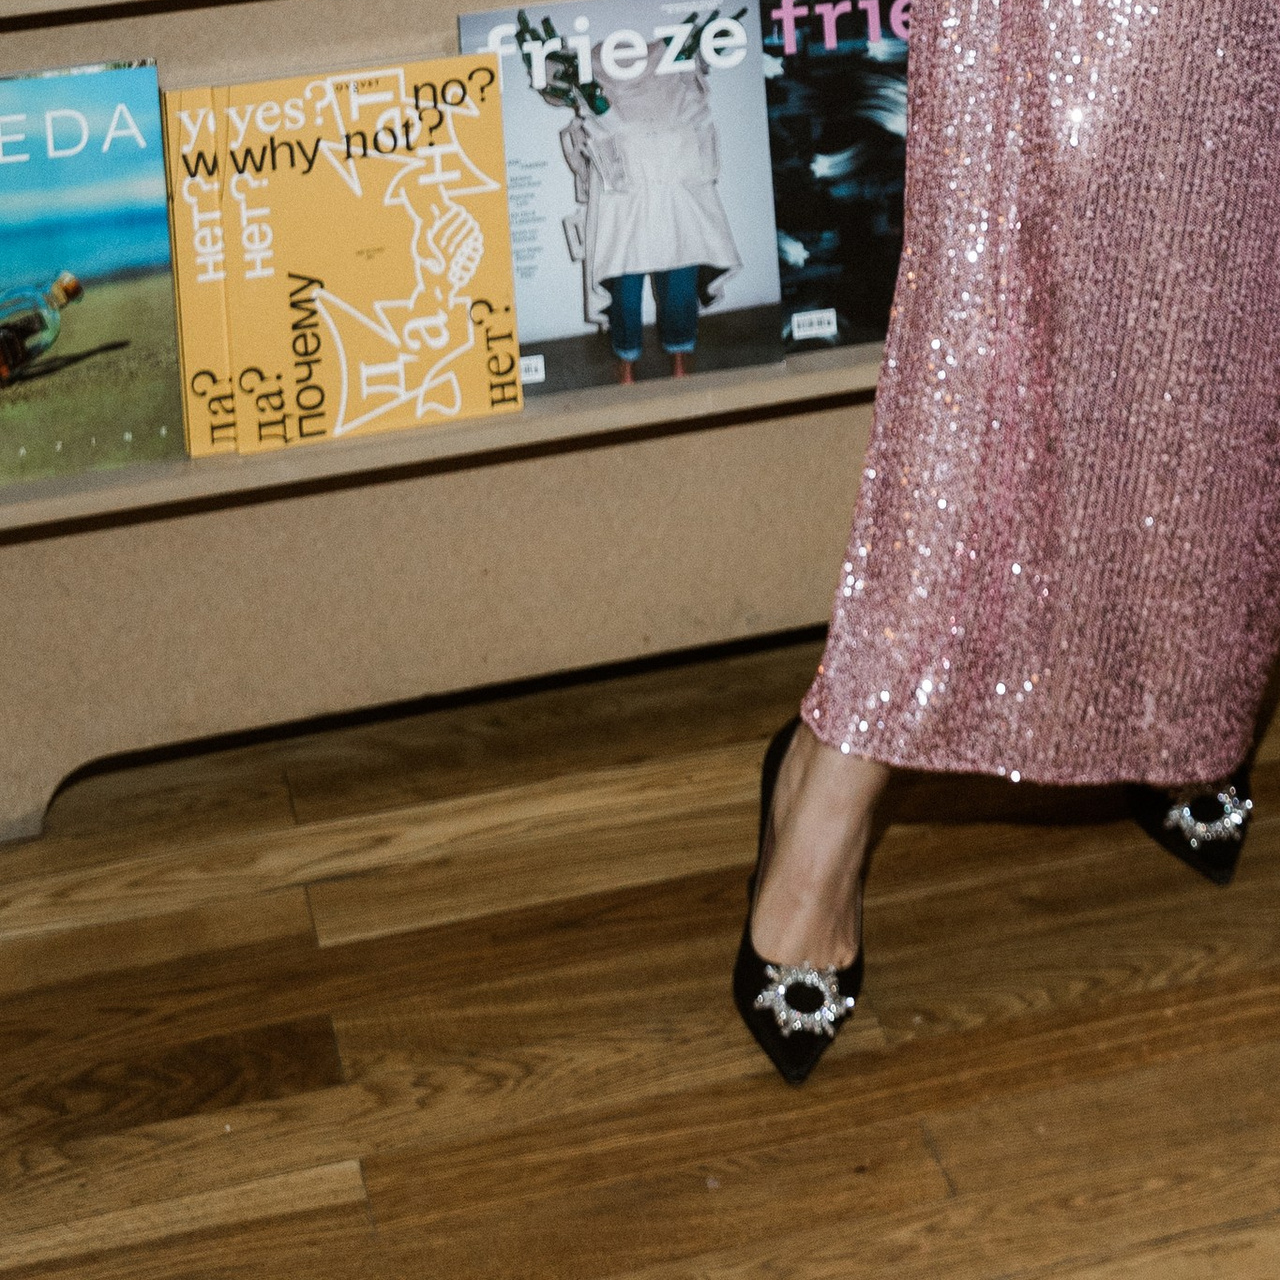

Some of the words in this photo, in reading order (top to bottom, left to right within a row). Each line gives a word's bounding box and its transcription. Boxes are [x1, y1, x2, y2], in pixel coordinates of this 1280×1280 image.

[476, 15, 750, 91] frieze
[226, 79, 332, 147] yes?
[414, 66, 497, 112] no?
[231, 135, 324, 175] why
[344, 110, 445, 162] not?
